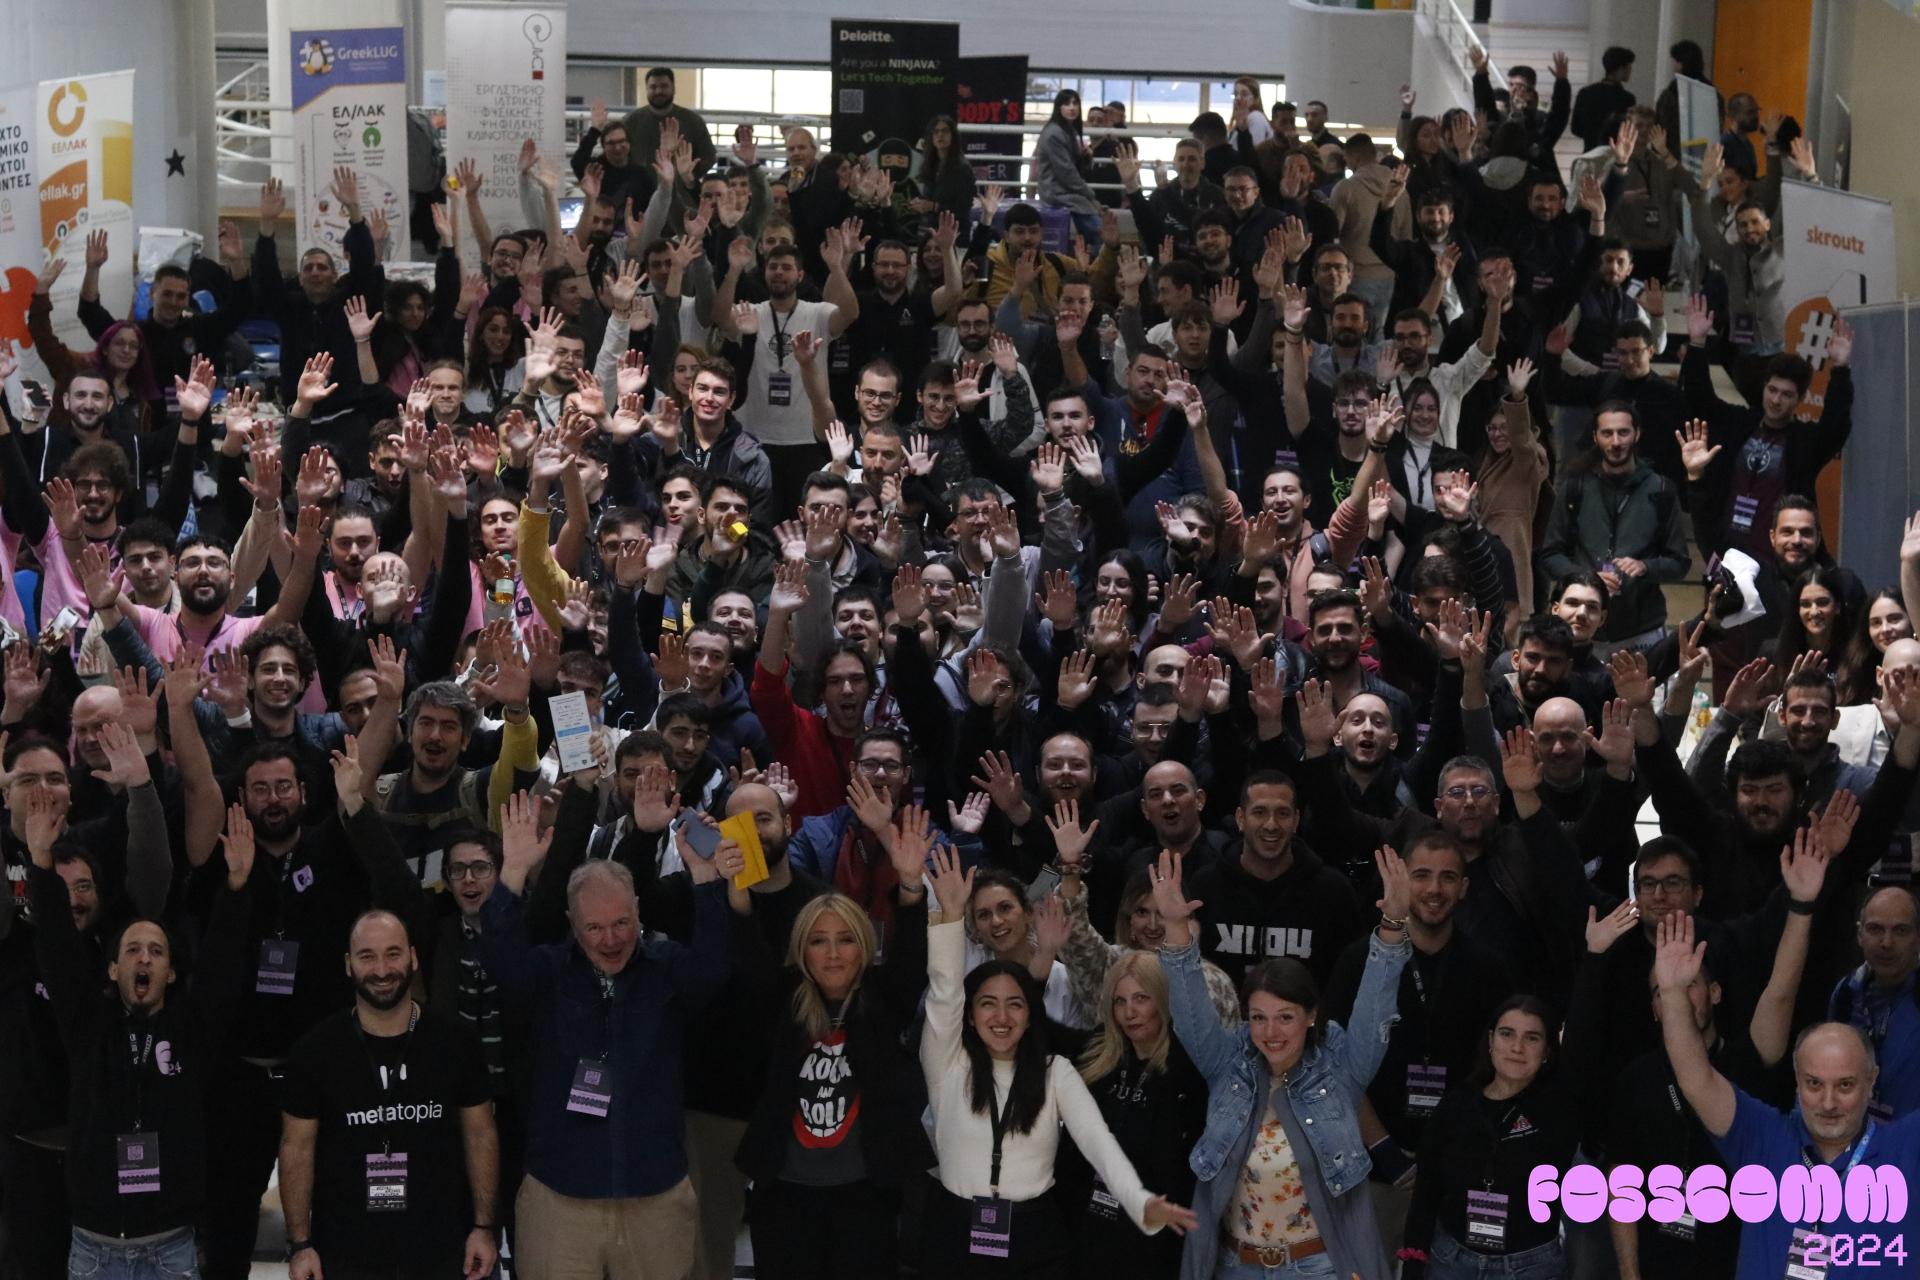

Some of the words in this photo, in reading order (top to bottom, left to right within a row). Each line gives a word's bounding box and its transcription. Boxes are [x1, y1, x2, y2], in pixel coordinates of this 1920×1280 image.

[338, 45, 398, 60] GreekLUG
[40, 182, 86, 201] ellak.gr
[1807, 225, 1865, 254] skroutz
[799, 1053, 852, 1083] ROCK
[346, 1100, 442, 1125] metatopia
[800, 1096, 845, 1127] ROLL
